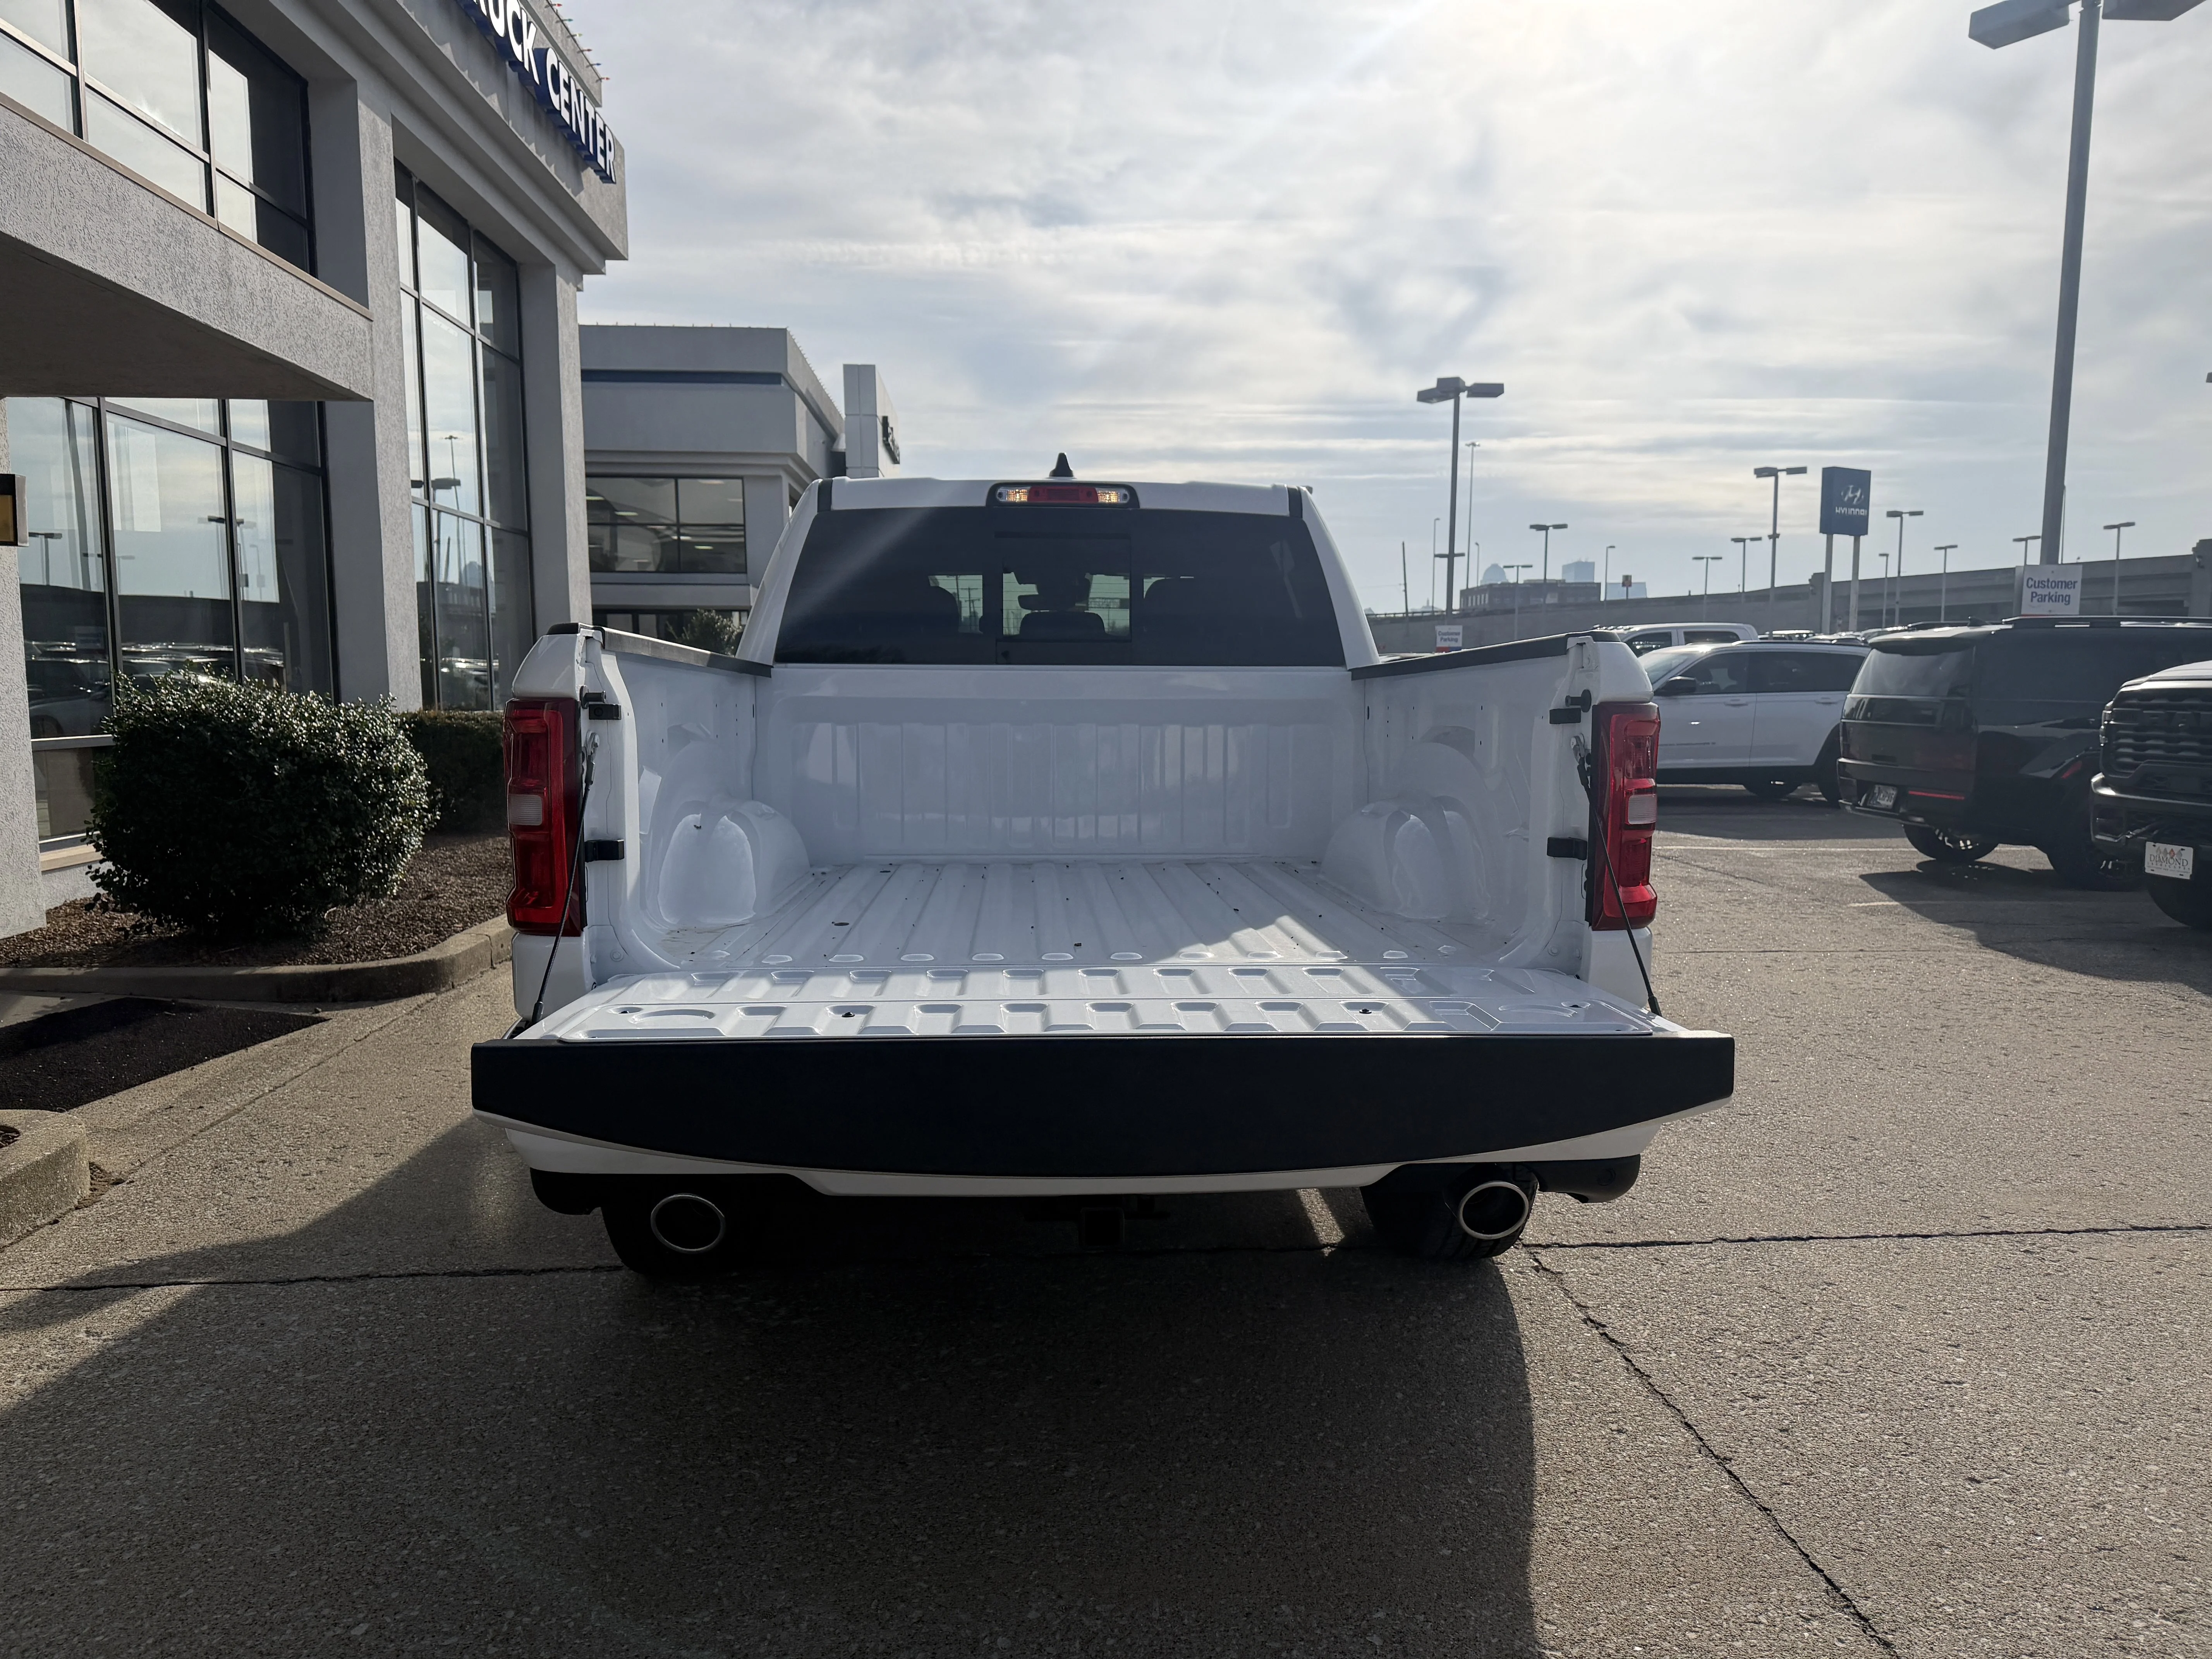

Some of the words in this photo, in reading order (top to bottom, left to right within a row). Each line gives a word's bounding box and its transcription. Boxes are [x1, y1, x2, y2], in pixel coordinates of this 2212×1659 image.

[473, 0, 540, 85] UCK
[546, 47, 616, 184] CENTER
[2026, 577, 2078, 590] Customer
[2030, 591, 2071, 606] Parking
[2150, 854, 2188, 867] DIAMOND
